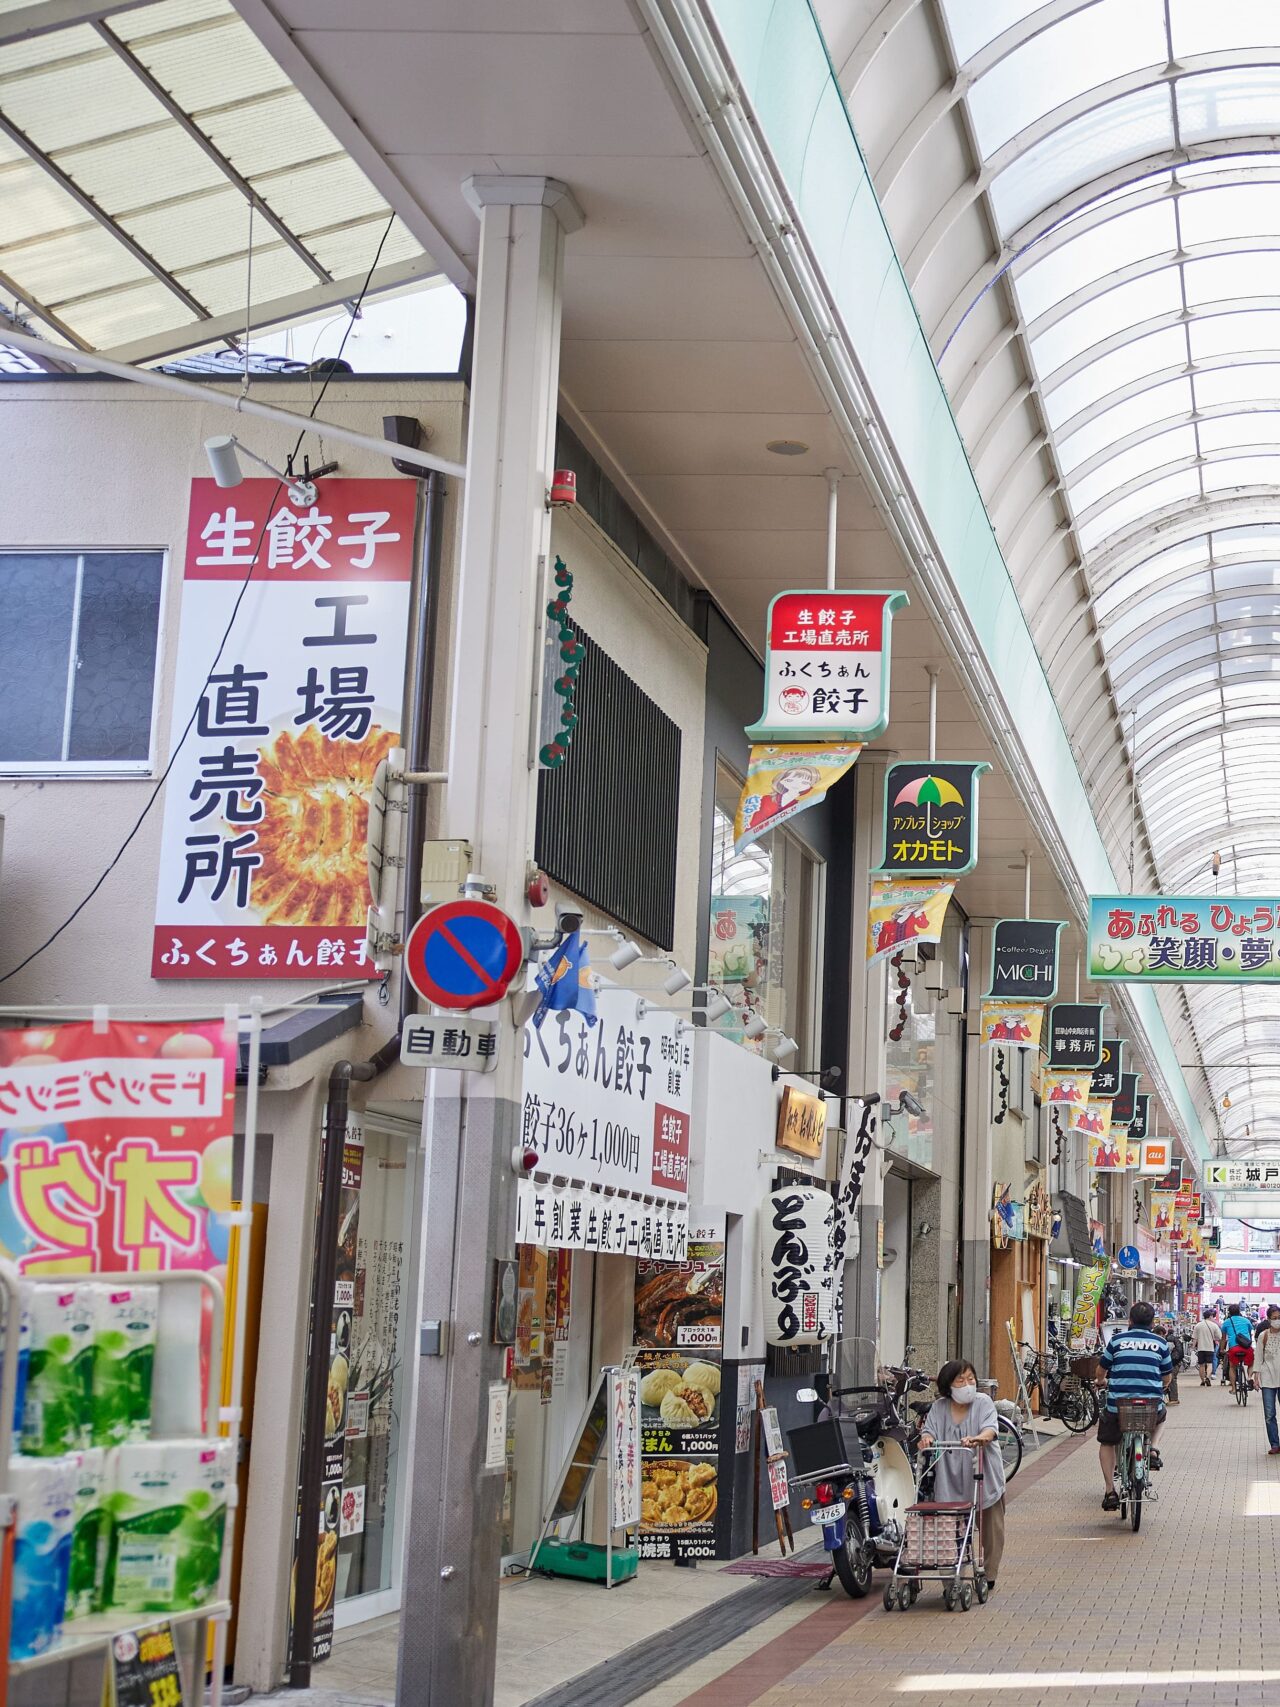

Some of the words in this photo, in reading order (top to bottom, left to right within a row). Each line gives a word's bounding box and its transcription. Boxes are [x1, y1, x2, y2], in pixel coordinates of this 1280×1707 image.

[195, 506, 401, 570] 生餃子
[797, 608, 857, 626] 生餃子
[782, 629, 870, 647] 工場直売所
[294, 594, 378, 741] 工場
[778, 660, 871, 679] ふくちぁん
[811, 687, 869, 715] 餃子
[177, 664, 270, 909] 直売所
[892, 839, 963, 862] オカモト
[1106, 904, 1200, 939] あふれる
[996, 963, 1053, 982] MICHI
[406, 1025, 496, 1057] 自動車
[1054, 1039, 1096, 1053] 事務所
[667, 1067, 682, 1097] 創業
[660, 1112, 683, 1146] 生餃子
[652, 1149, 688, 1184] 工場直売所
[1148, 1151, 1163, 1159] au
[771, 1193, 816, 1341] どんぶり
[680, 1333, 718, 1343] 1,000円
[1120, 1341, 1160, 1352] SANYO
[681, 1440, 719, 1452] 1,000円
[677, 1546, 716, 1558] 1,000円
